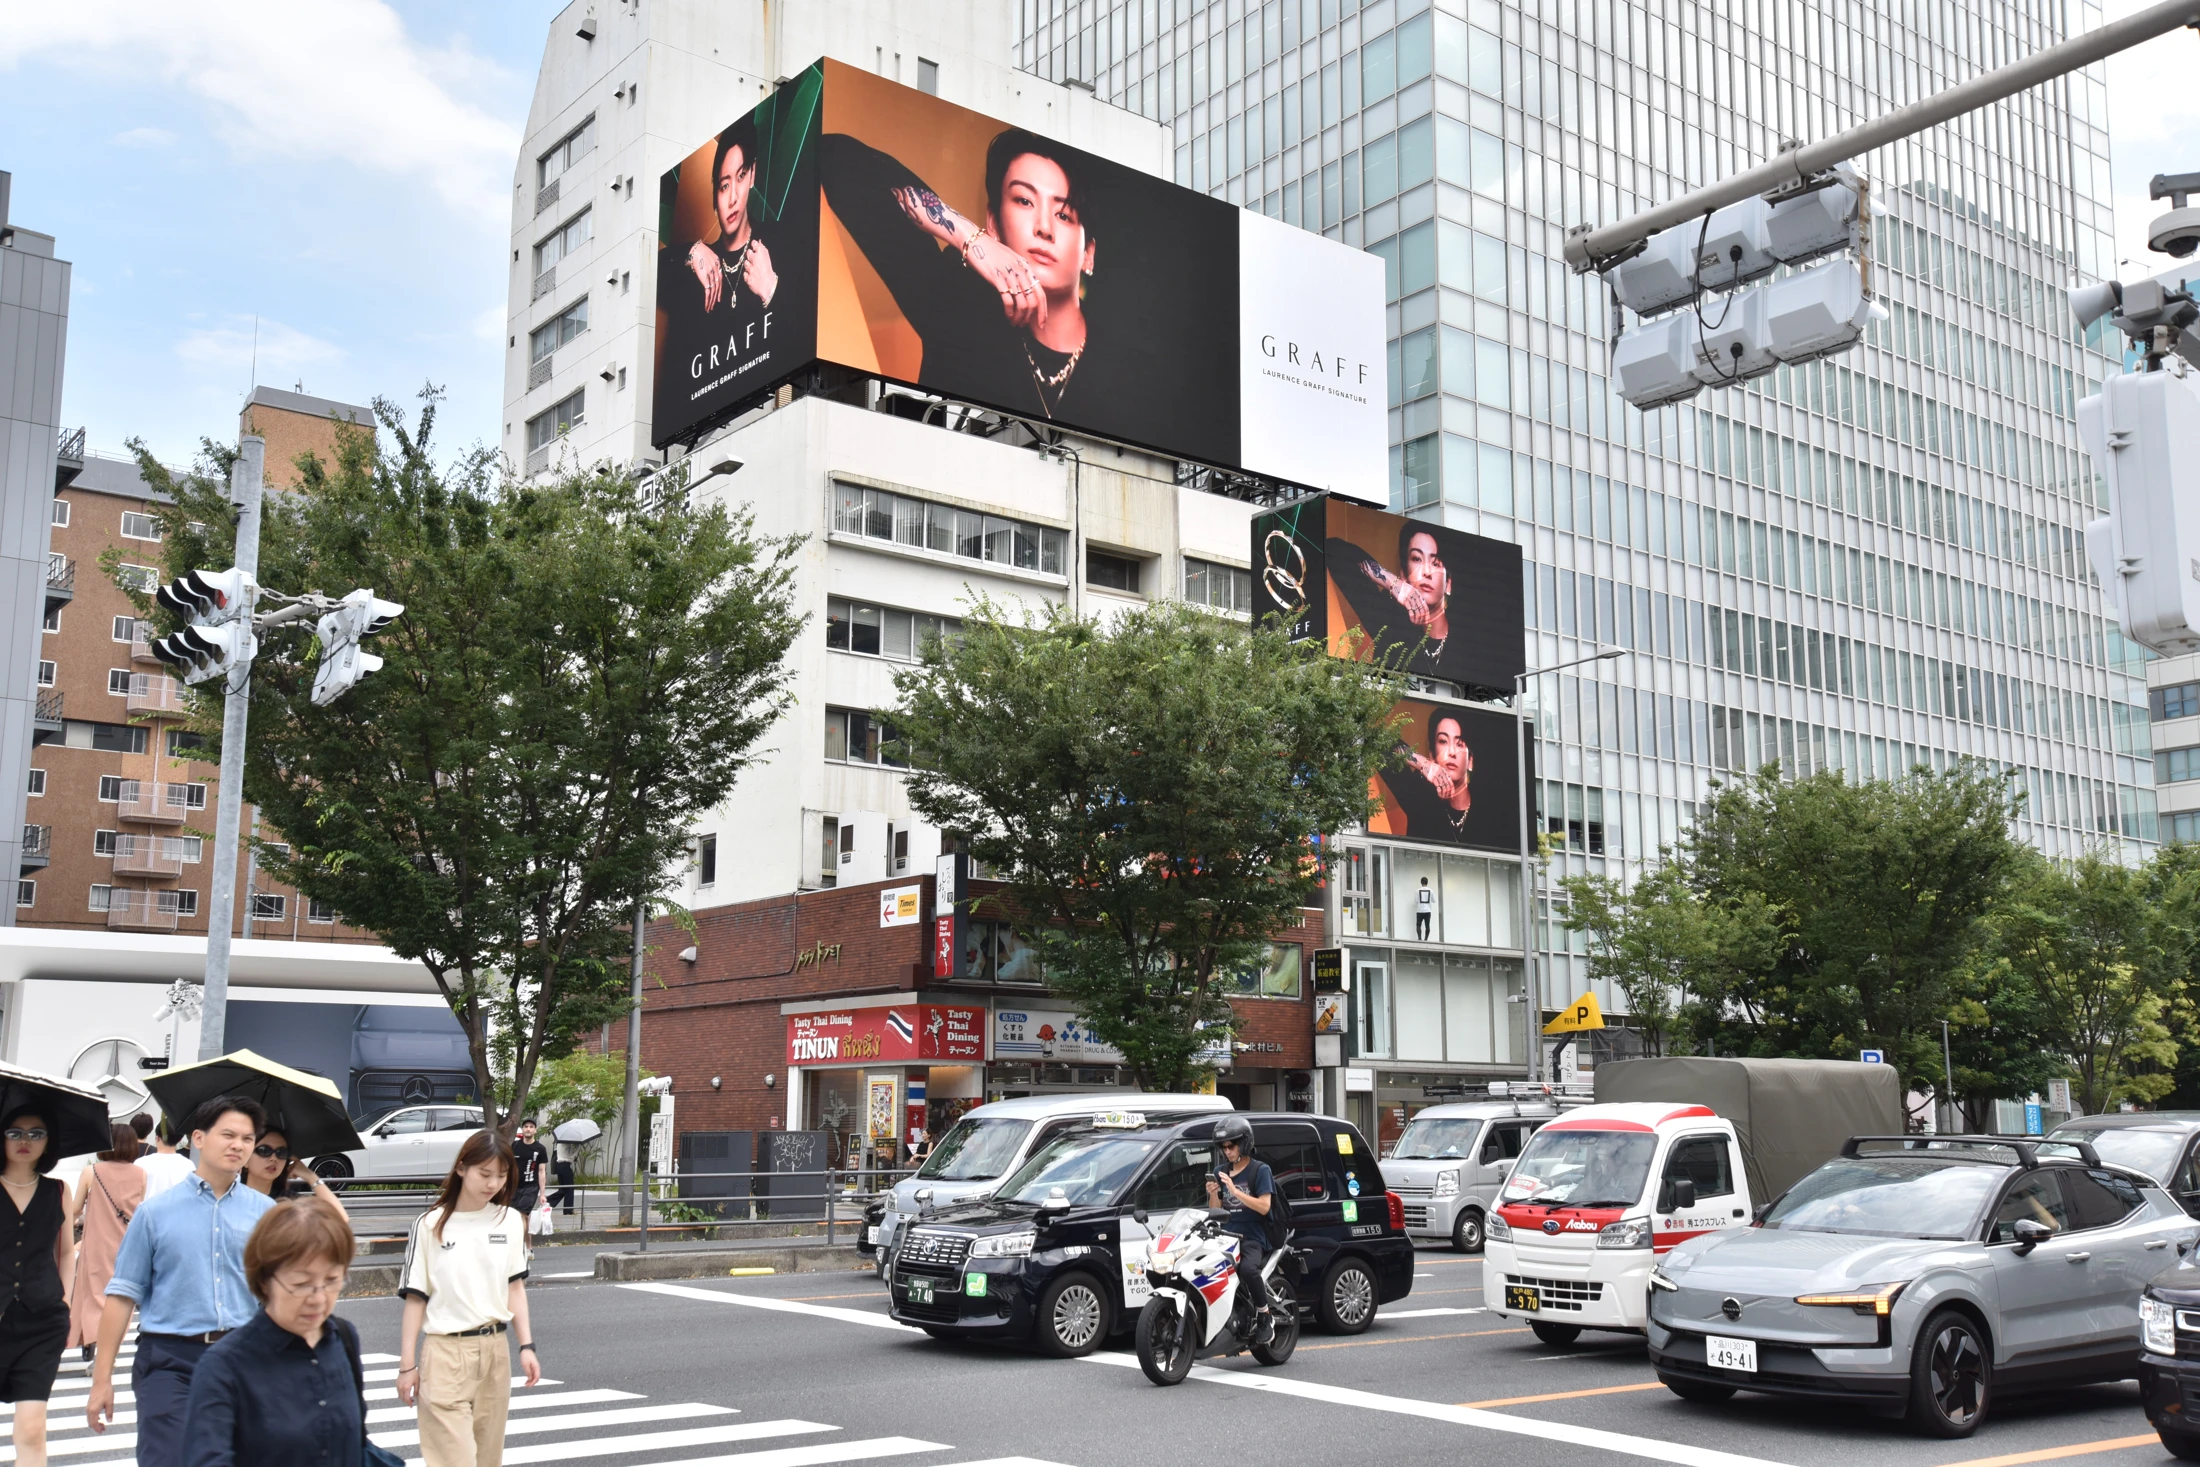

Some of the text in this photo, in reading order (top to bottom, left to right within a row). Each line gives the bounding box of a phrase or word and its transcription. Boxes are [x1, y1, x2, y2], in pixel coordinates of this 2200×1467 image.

[691, 312, 773, 379] GRAFF
[1261, 335, 1368, 385] GRAFF
[691, 351, 771, 401] LAURENCE GRAFF SIGNATURE
[1262, 368, 1367, 404] LAURENCE GRAFF SIGNATURE
[900, 899, 915, 907] Times
[947, 1009, 973, 1020] Tasty
[1002, 1013, 1026, 1022] 処方せん
[1577, 1006, 1589, 1025] P
[794, 1014, 853, 1029] Tasty Thai Dining
[947, 1021, 969, 1030] Thai
[796, 1029, 819, 1038] ティーヌン
[1003, 1024, 1024, 1032] くすり
[947, 1032, 979, 1043] Dining
[1002, 1033, 1024, 1041] 化粧品
[792, 1037, 839, 1060] TINUN
[948, 1046, 977, 1055] ティーヌン
[1248, 1042, 1284, 1052] 北村ビル
[1123, 1115, 1135, 1124] 150
[1687, 1217, 1727, 1228] 秀エクスプレス
[1130, 1286, 1150, 1294] でGO!
[1718, 1350, 1752, 1369] 49-41
